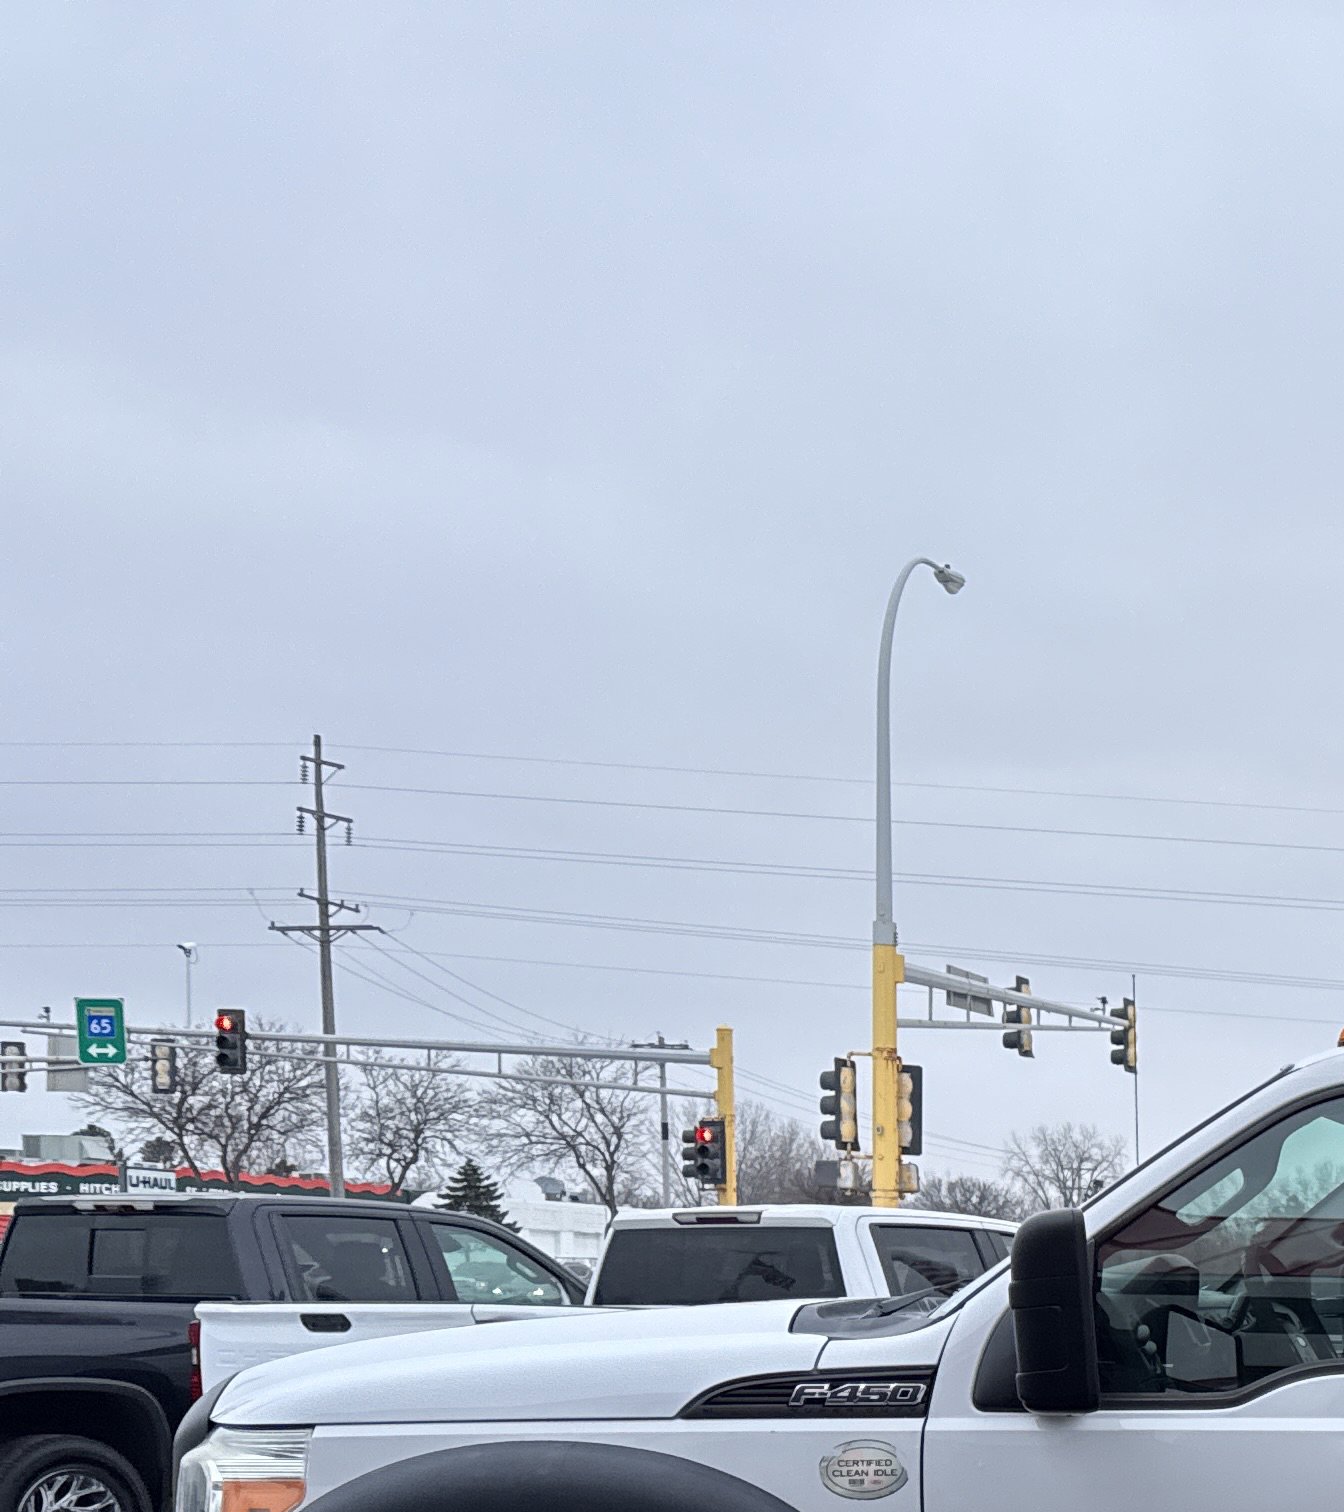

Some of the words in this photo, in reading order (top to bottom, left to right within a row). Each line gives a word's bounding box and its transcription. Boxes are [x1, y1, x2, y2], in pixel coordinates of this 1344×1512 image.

[89, 1018, 112, 1034] 65
[128, 1175, 175, 1190] U-HAUL
[788, 1383, 927, 1406] F-450
[837, 1459, 893, 1467] CERTIFIED
[832, 1469, 869, 1477] CLEAN
